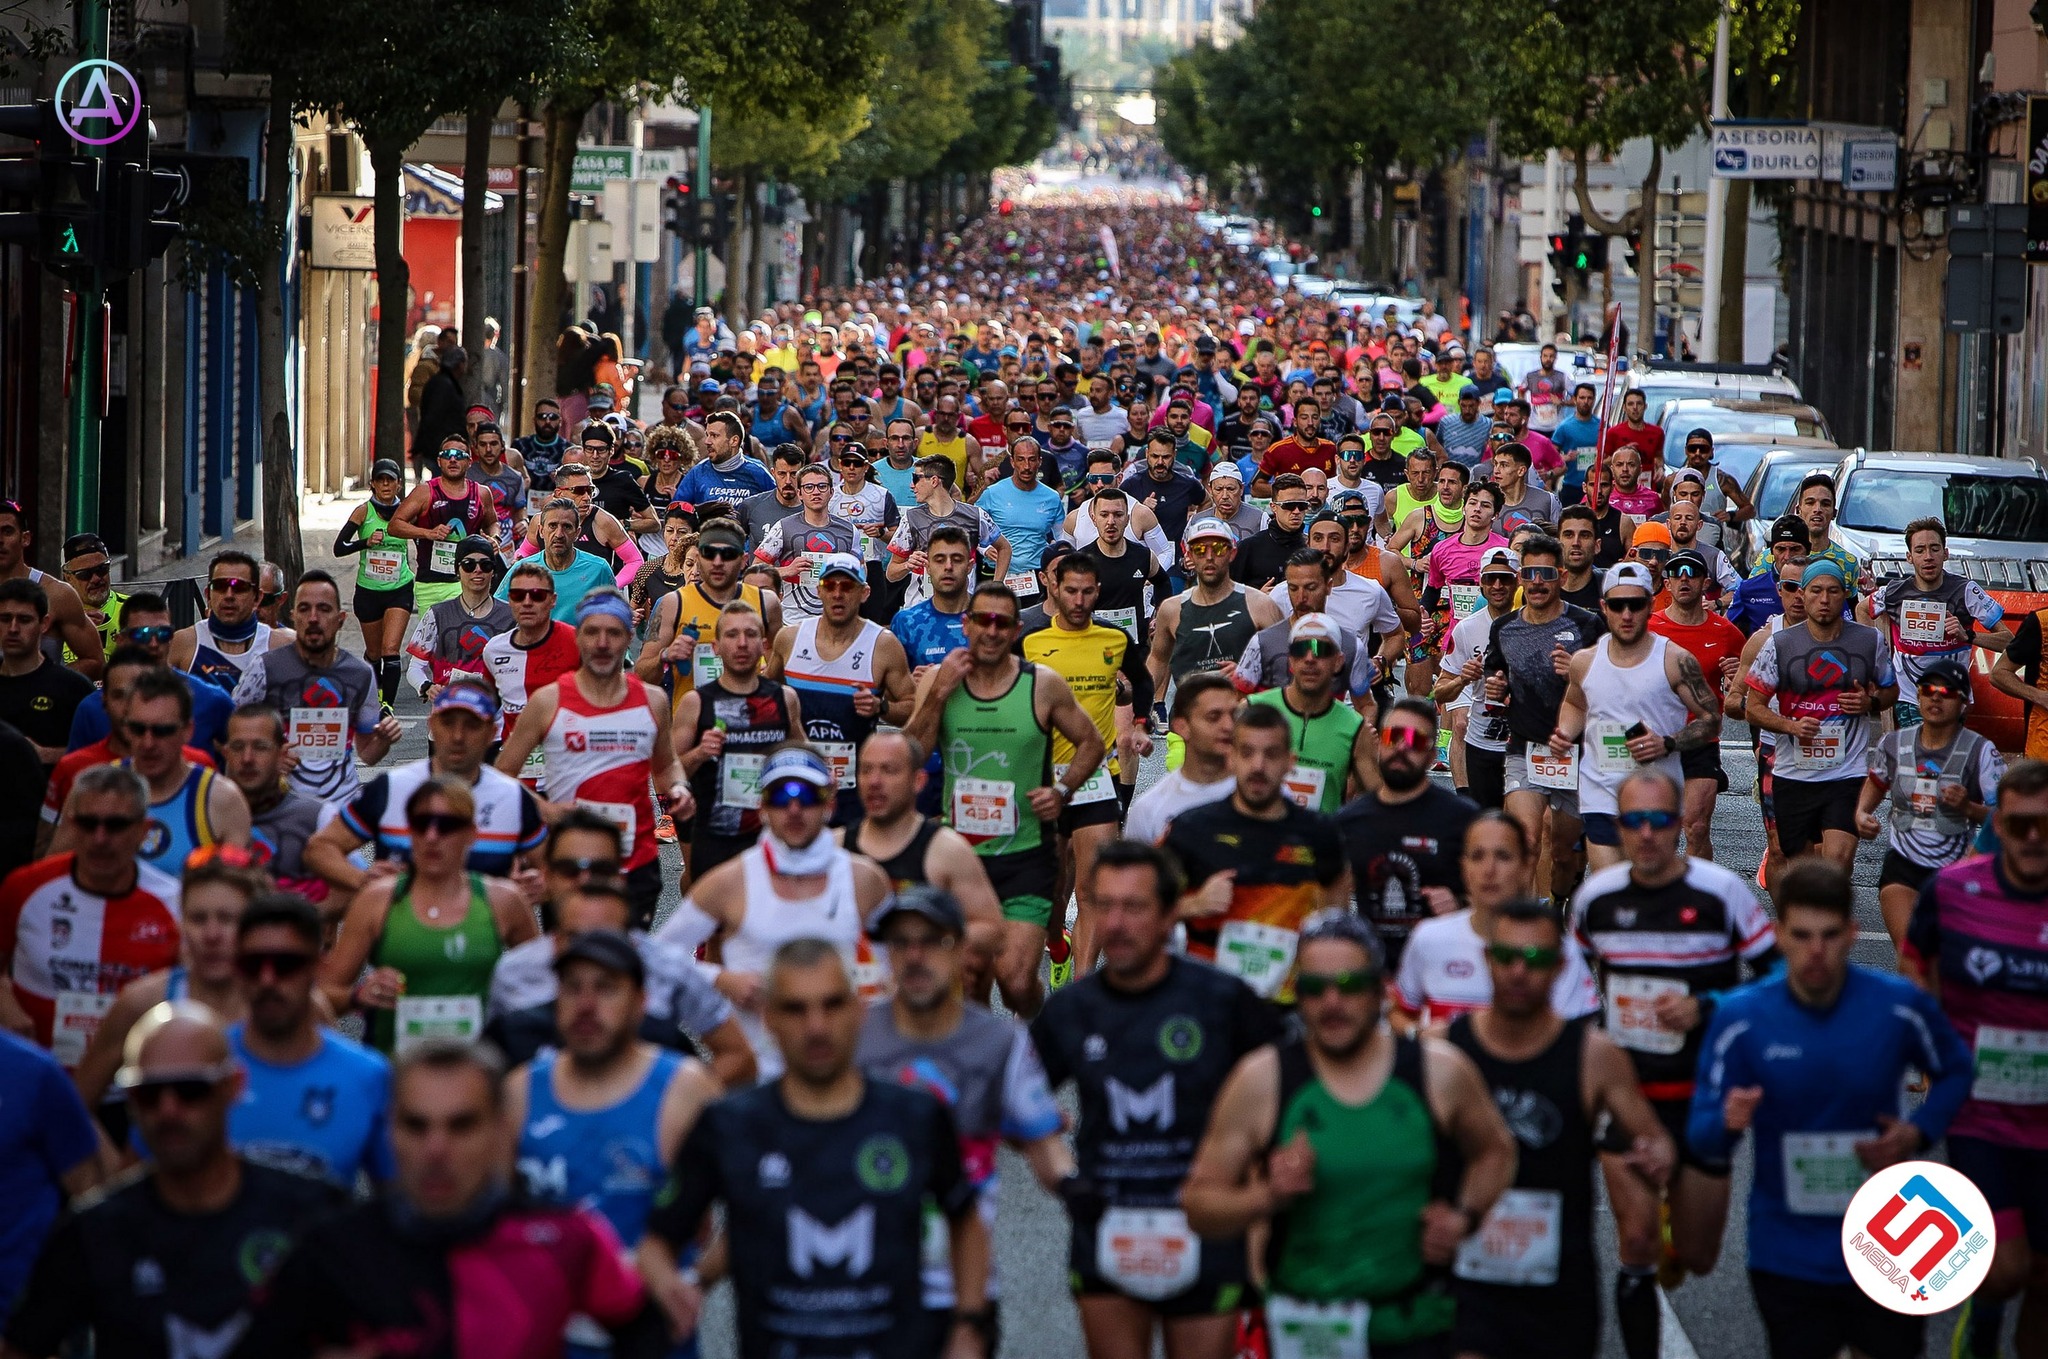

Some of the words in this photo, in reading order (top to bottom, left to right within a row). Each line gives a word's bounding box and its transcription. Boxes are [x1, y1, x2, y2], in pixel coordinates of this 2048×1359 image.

[1717, 129, 1817, 145] ASESORIA
[1752, 152, 1818, 170] BURLÓ
[372, 565, 393, 575] 1195
[1907, 620, 1936, 631] 846
[809, 726, 844, 740] APM
[1802, 748, 1835, 758] 900
[1535, 765, 1568, 777] 904
